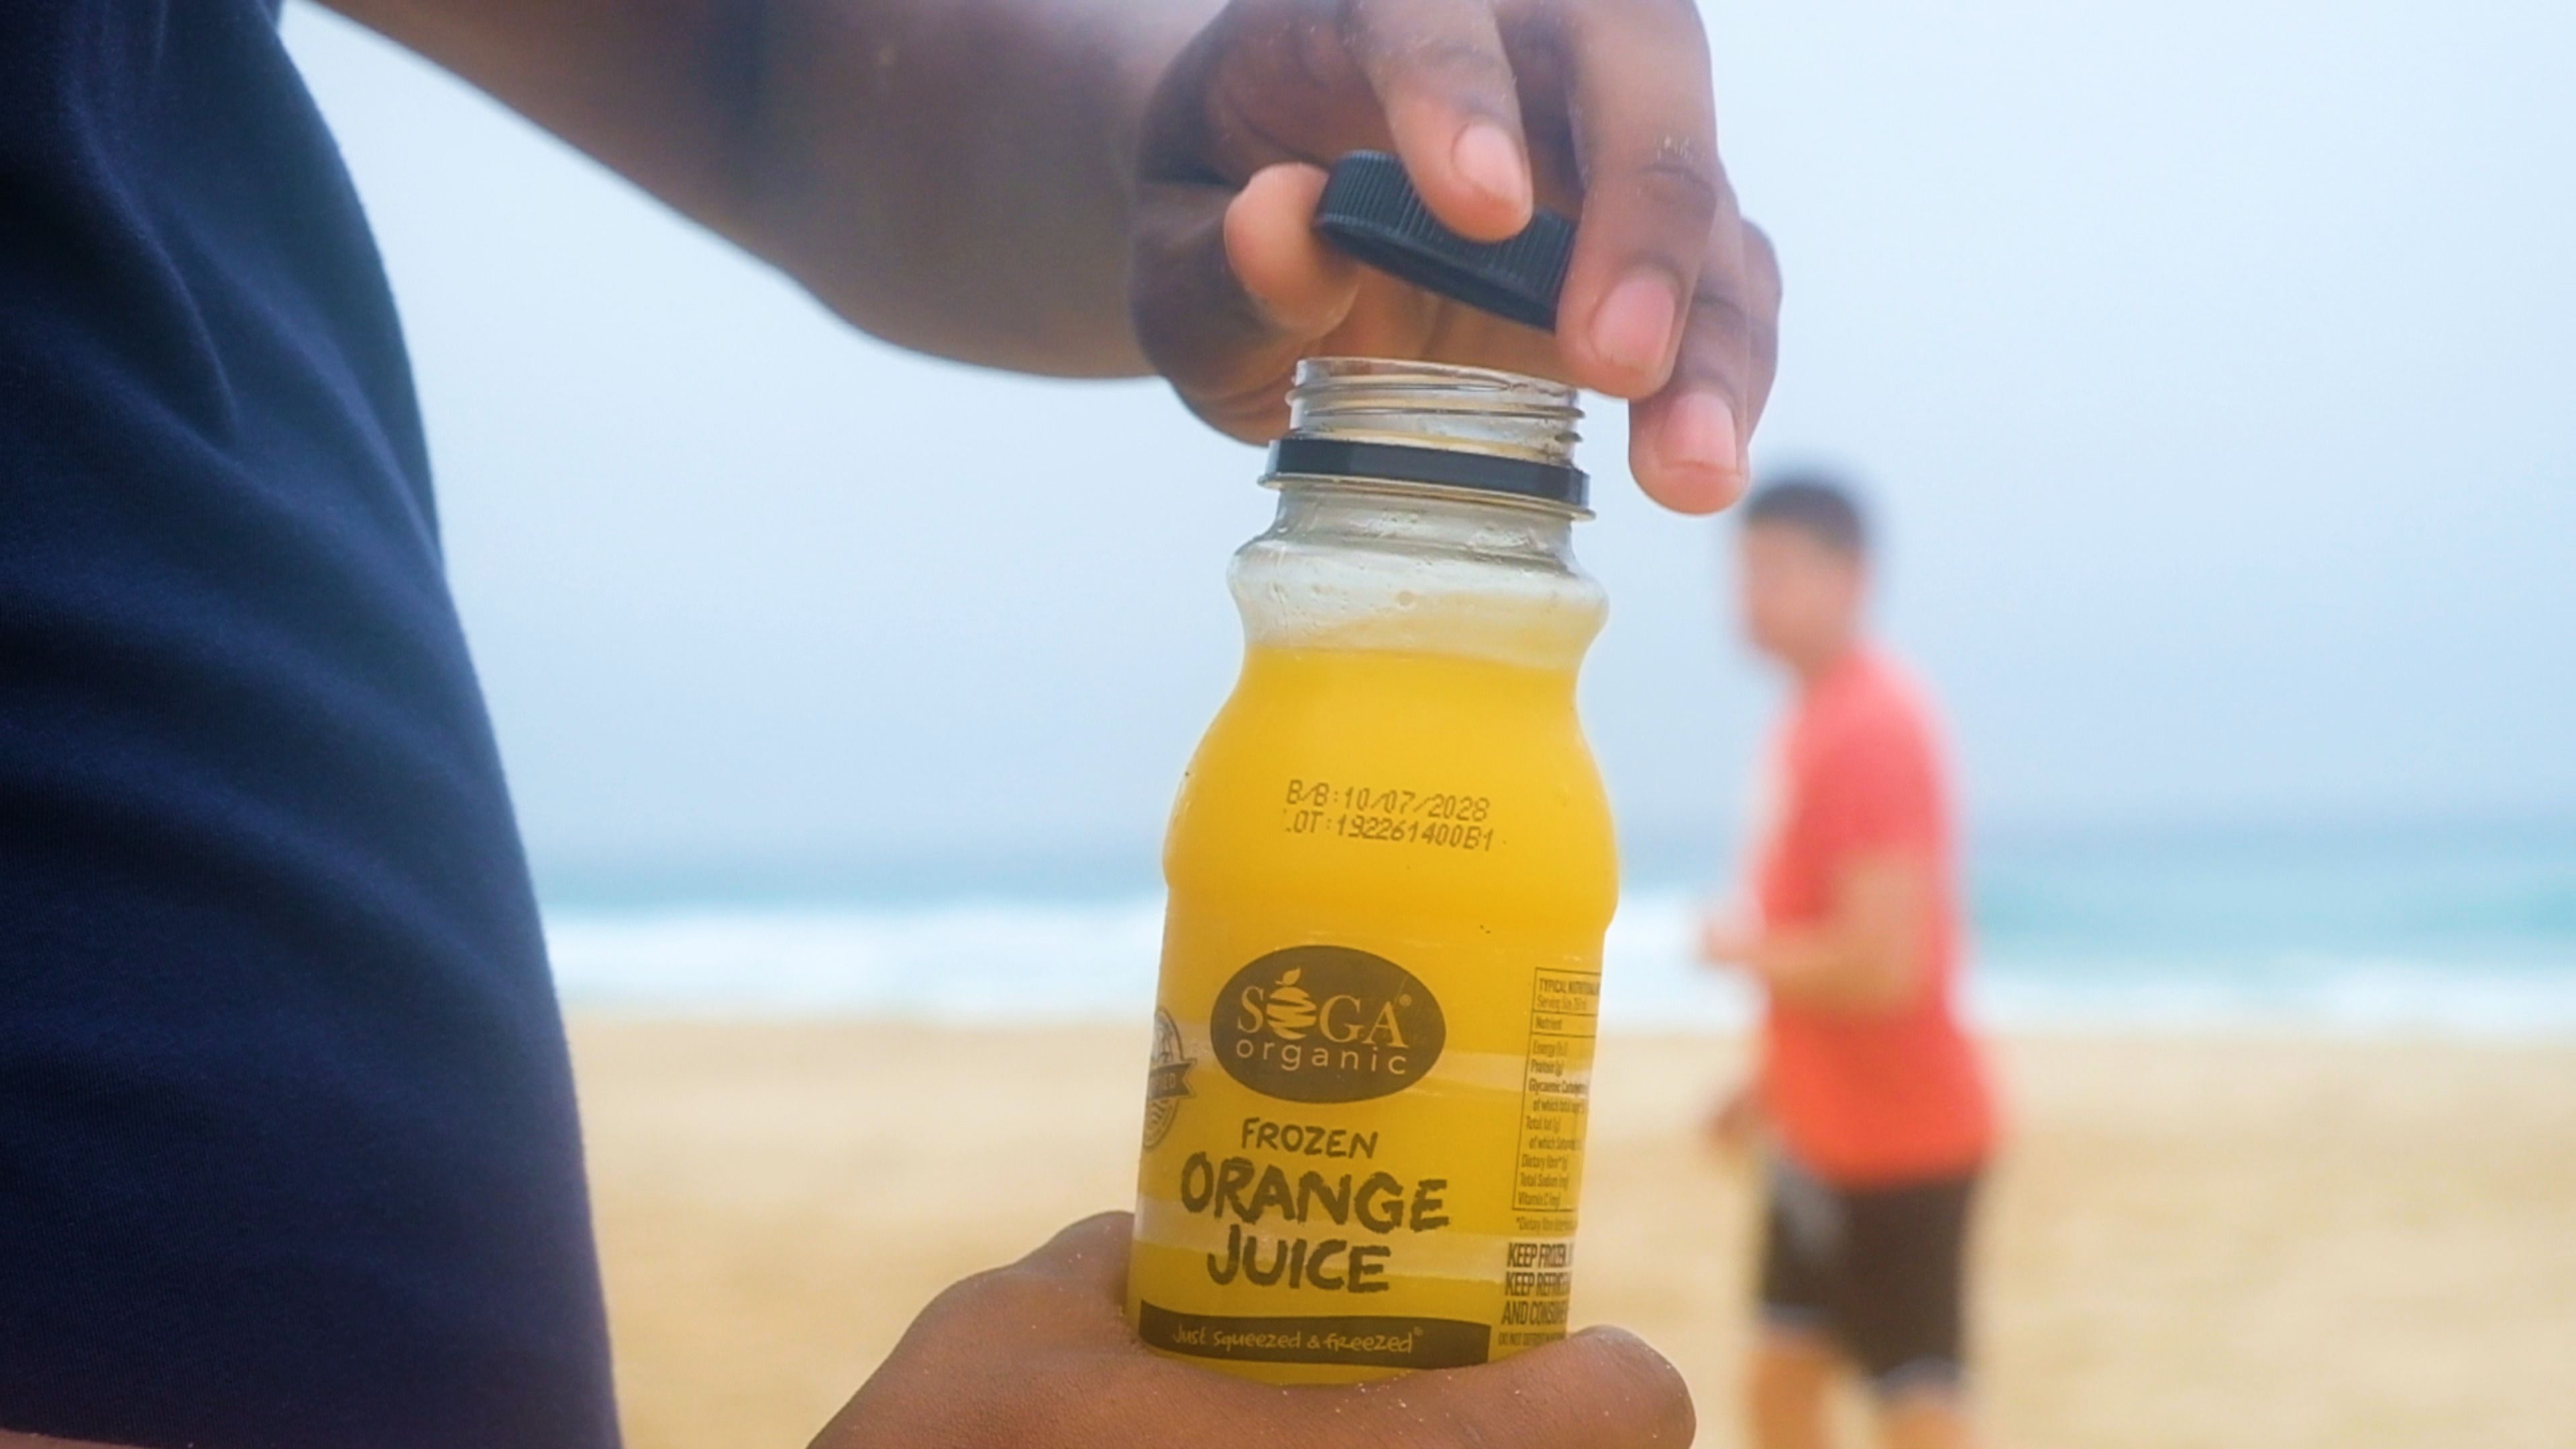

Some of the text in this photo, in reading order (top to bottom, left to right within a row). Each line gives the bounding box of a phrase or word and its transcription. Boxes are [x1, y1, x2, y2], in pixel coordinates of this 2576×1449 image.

[1236, 1038, 1408, 1076] organic
[1241, 1116, 1379, 1160] FROZEN
[1180, 1150, 1450, 1234] ORANGE
[1206, 1224, 1392, 1293] JUICE
[1507, 1242, 1538, 1267] KEEP
[1505, 1271, 1535, 1295] KEEP
[1501, 1300, 1529, 1325] AND
[1213, 1330, 1301, 1352] squeezed
[1307, 1335, 1321, 1350] &
